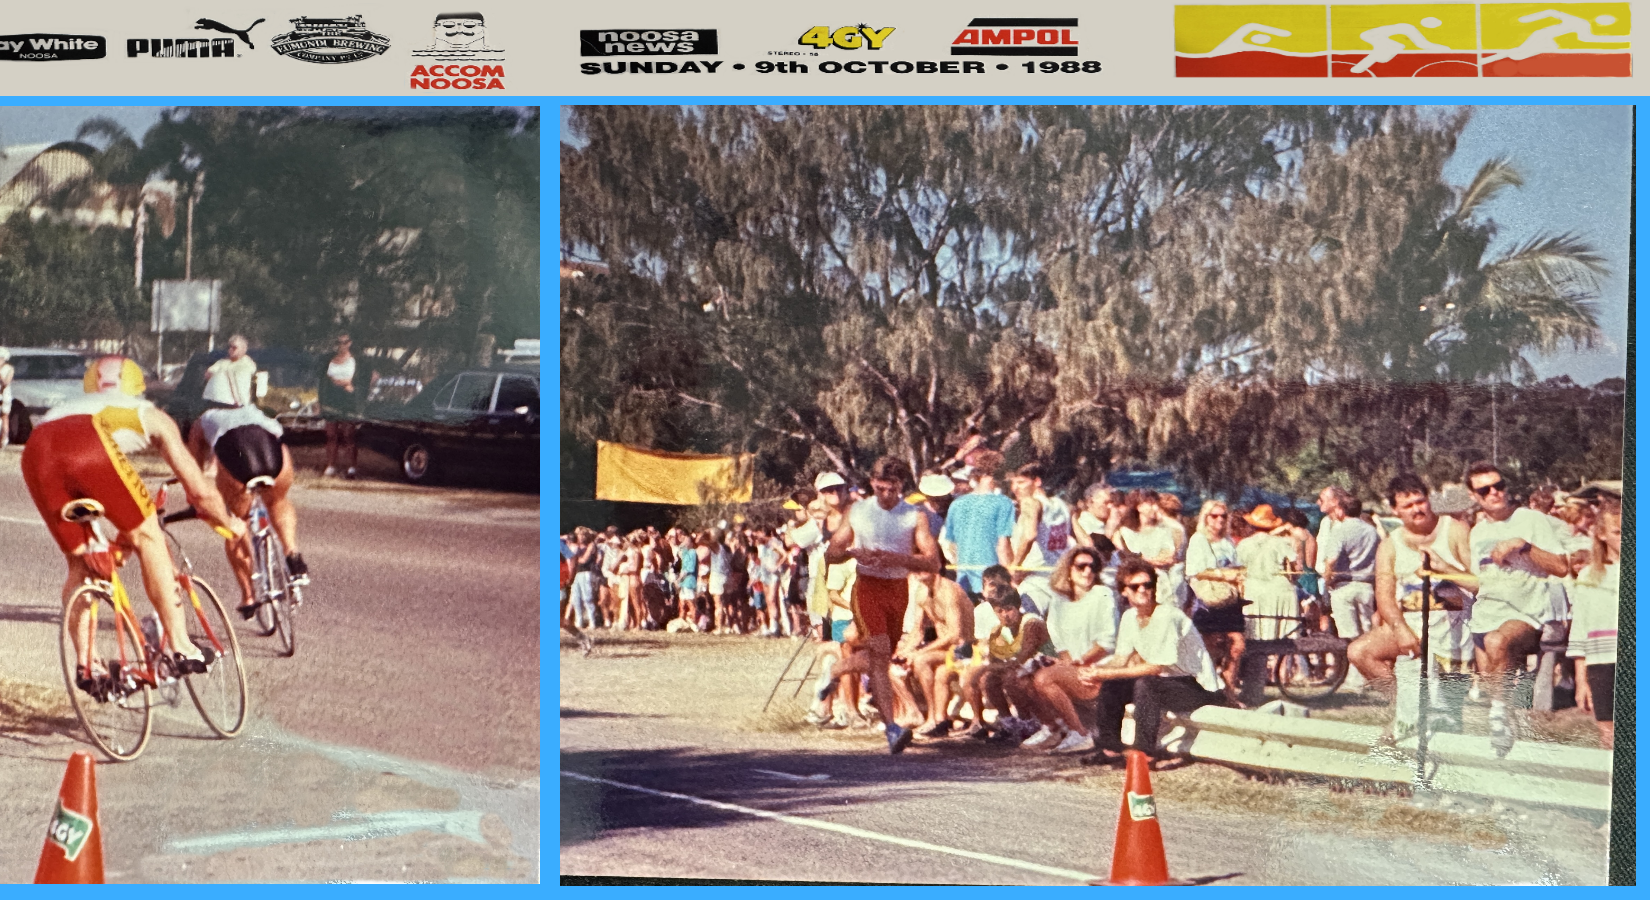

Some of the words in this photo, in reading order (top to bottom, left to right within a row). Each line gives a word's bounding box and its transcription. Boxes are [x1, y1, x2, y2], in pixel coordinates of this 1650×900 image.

[598, 31, 699, 42] noosa
[798, 25, 896, 50] 4GY
[951, 29, 1079, 45] AMPOL
[29, 38, 99, 50] White
[127, 38, 234, 58] PUMA
[276, 39, 328, 53] EUMUNDI
[333, 39, 386, 53] BREWING
[604, 42, 694, 53] news
[410, 65, 505, 77] ACCOM
[580, 61, 724, 75] SUNDAY
[755, 61, 808, 73] 9th
[819, 61, 985, 74] OCTOBER
[1022, 61, 1102, 74] 1988
[410, 78, 505, 89] NOOSA
